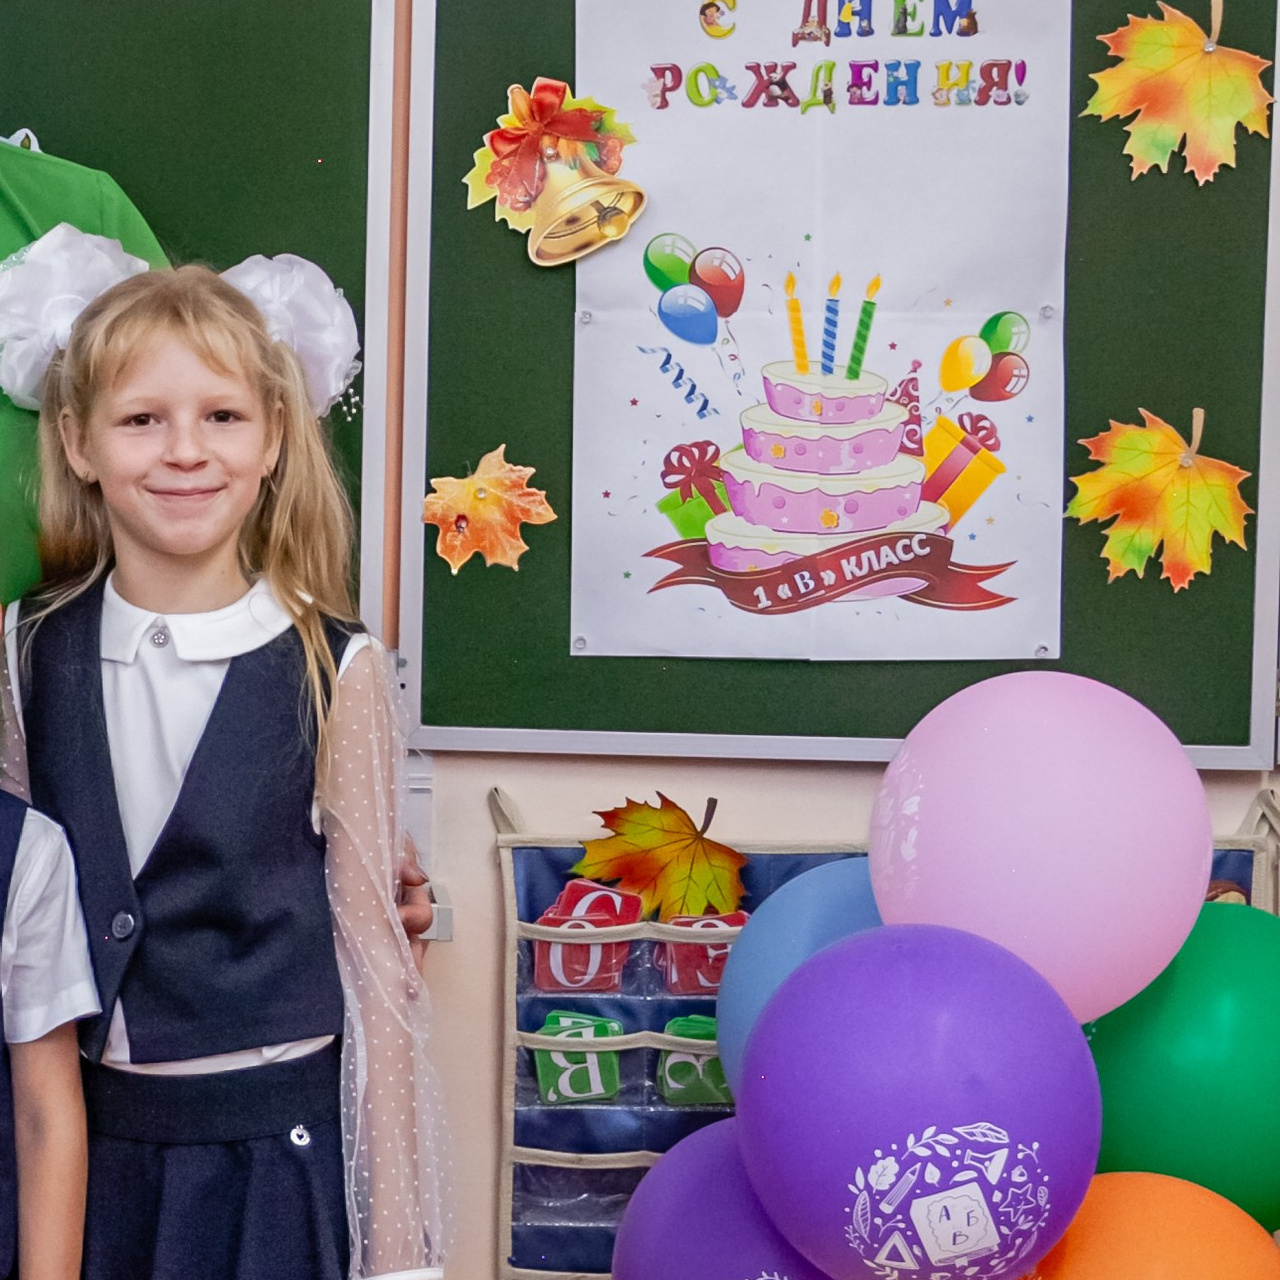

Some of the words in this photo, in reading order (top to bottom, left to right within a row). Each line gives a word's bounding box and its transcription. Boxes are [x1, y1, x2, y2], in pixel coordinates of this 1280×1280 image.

[644, 60, 1029, 114] РОЖДЕНИЯ!
[753, 586, 772, 609] 1
[840, 534, 931, 581] КЛАСС
